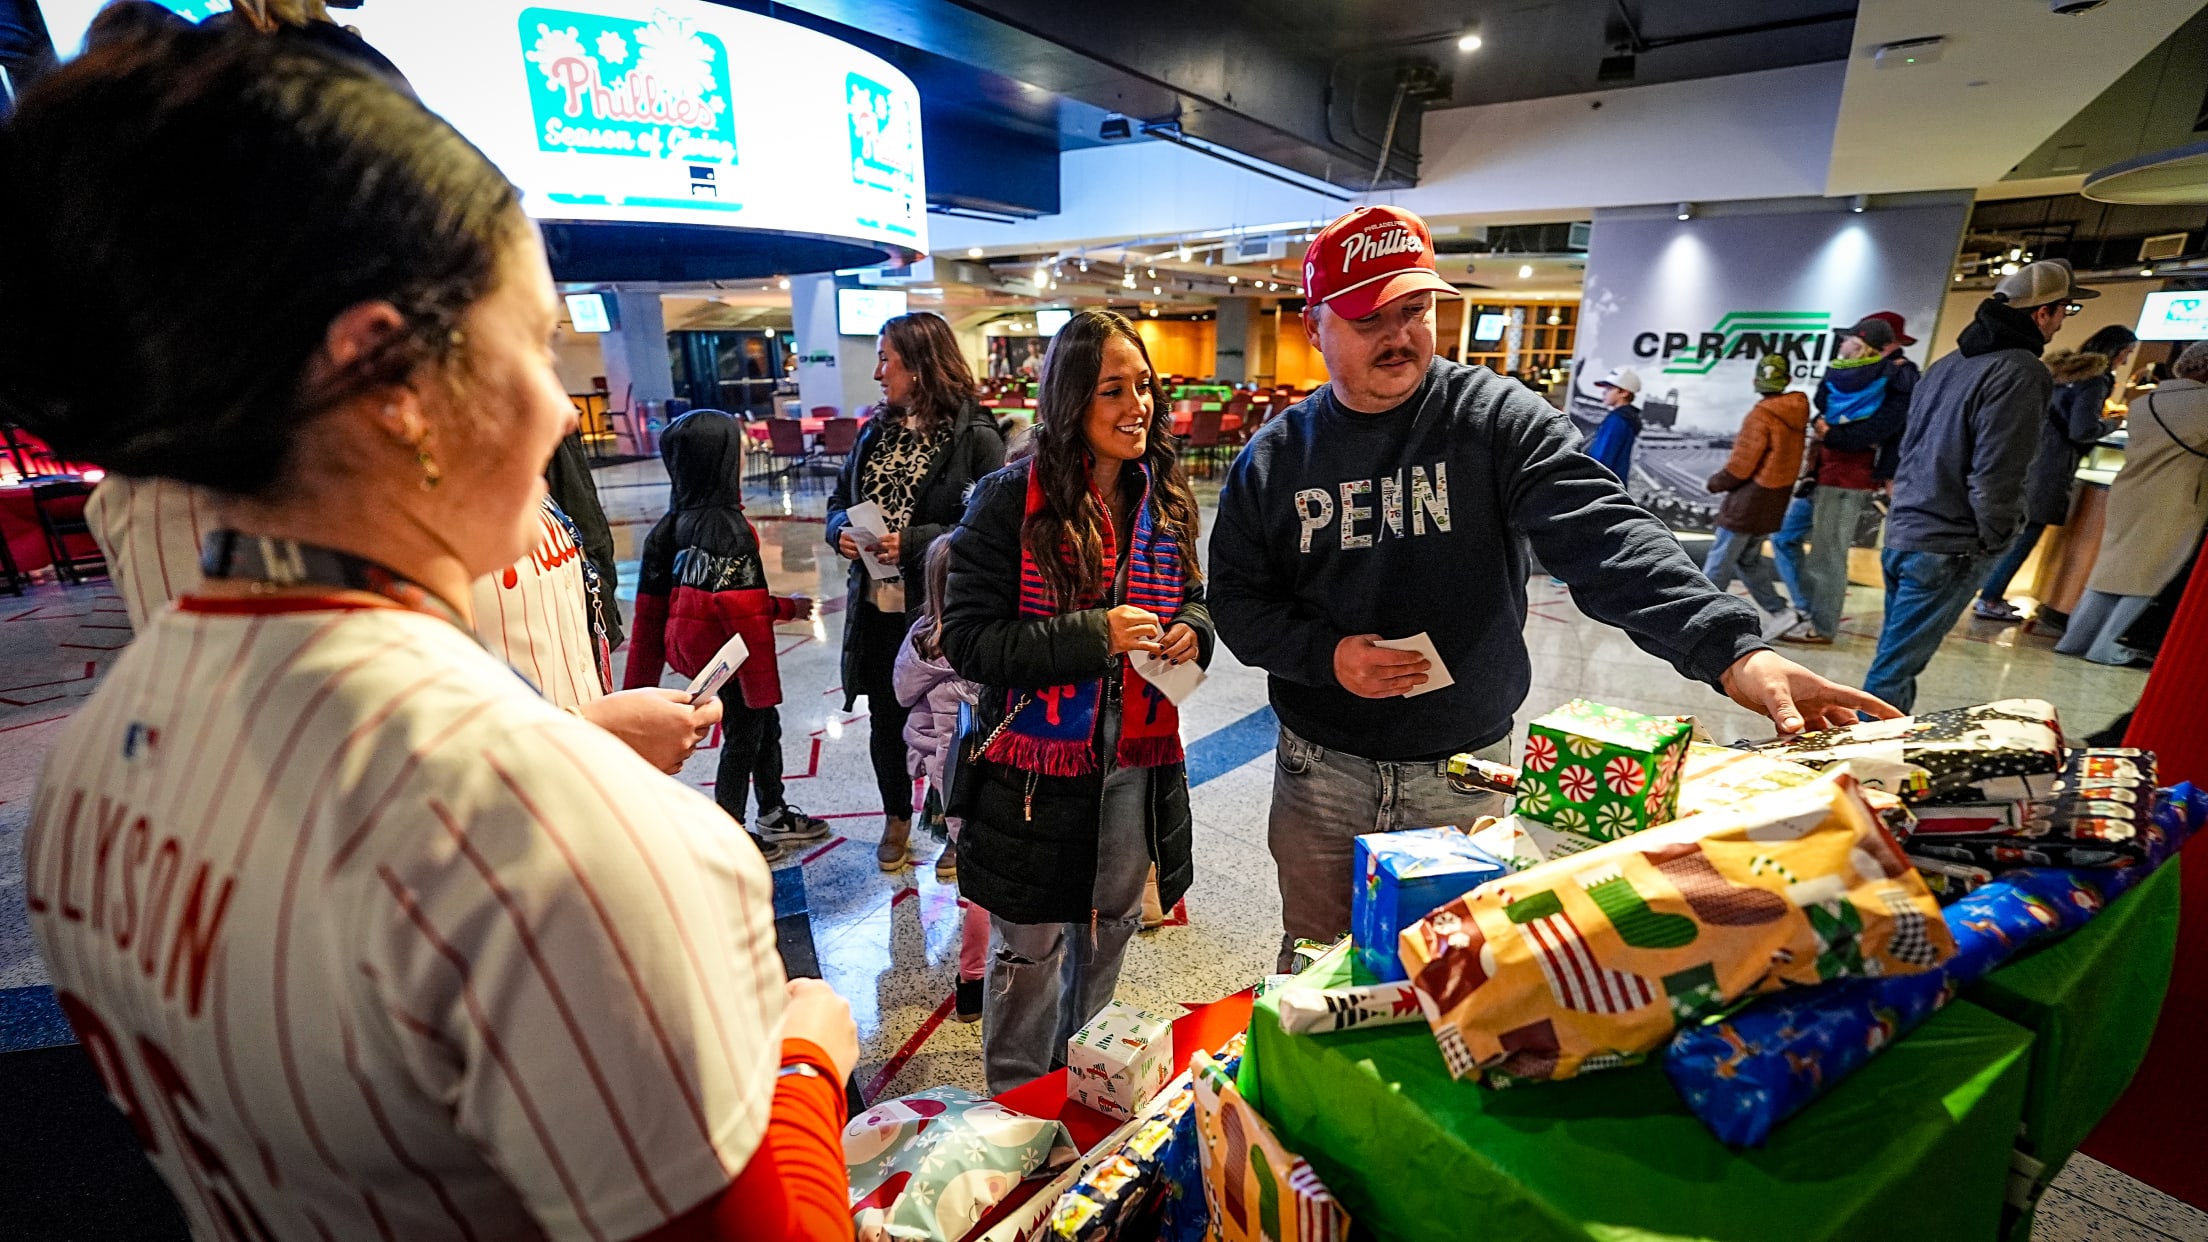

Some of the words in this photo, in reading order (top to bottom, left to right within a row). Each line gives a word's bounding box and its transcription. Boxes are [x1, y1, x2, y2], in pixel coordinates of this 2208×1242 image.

[552, 57, 714, 128] Phillies
[545, 117, 636, 151] Season
[637, 127, 664, 159] of
[666, 126, 736, 162] Giving
[1340, 228, 1424, 273] Phillies
[1633, 332, 1689, 359] CP
[1794, 364, 1823, 379] CL
[1295, 461, 1451, 553] PENN
